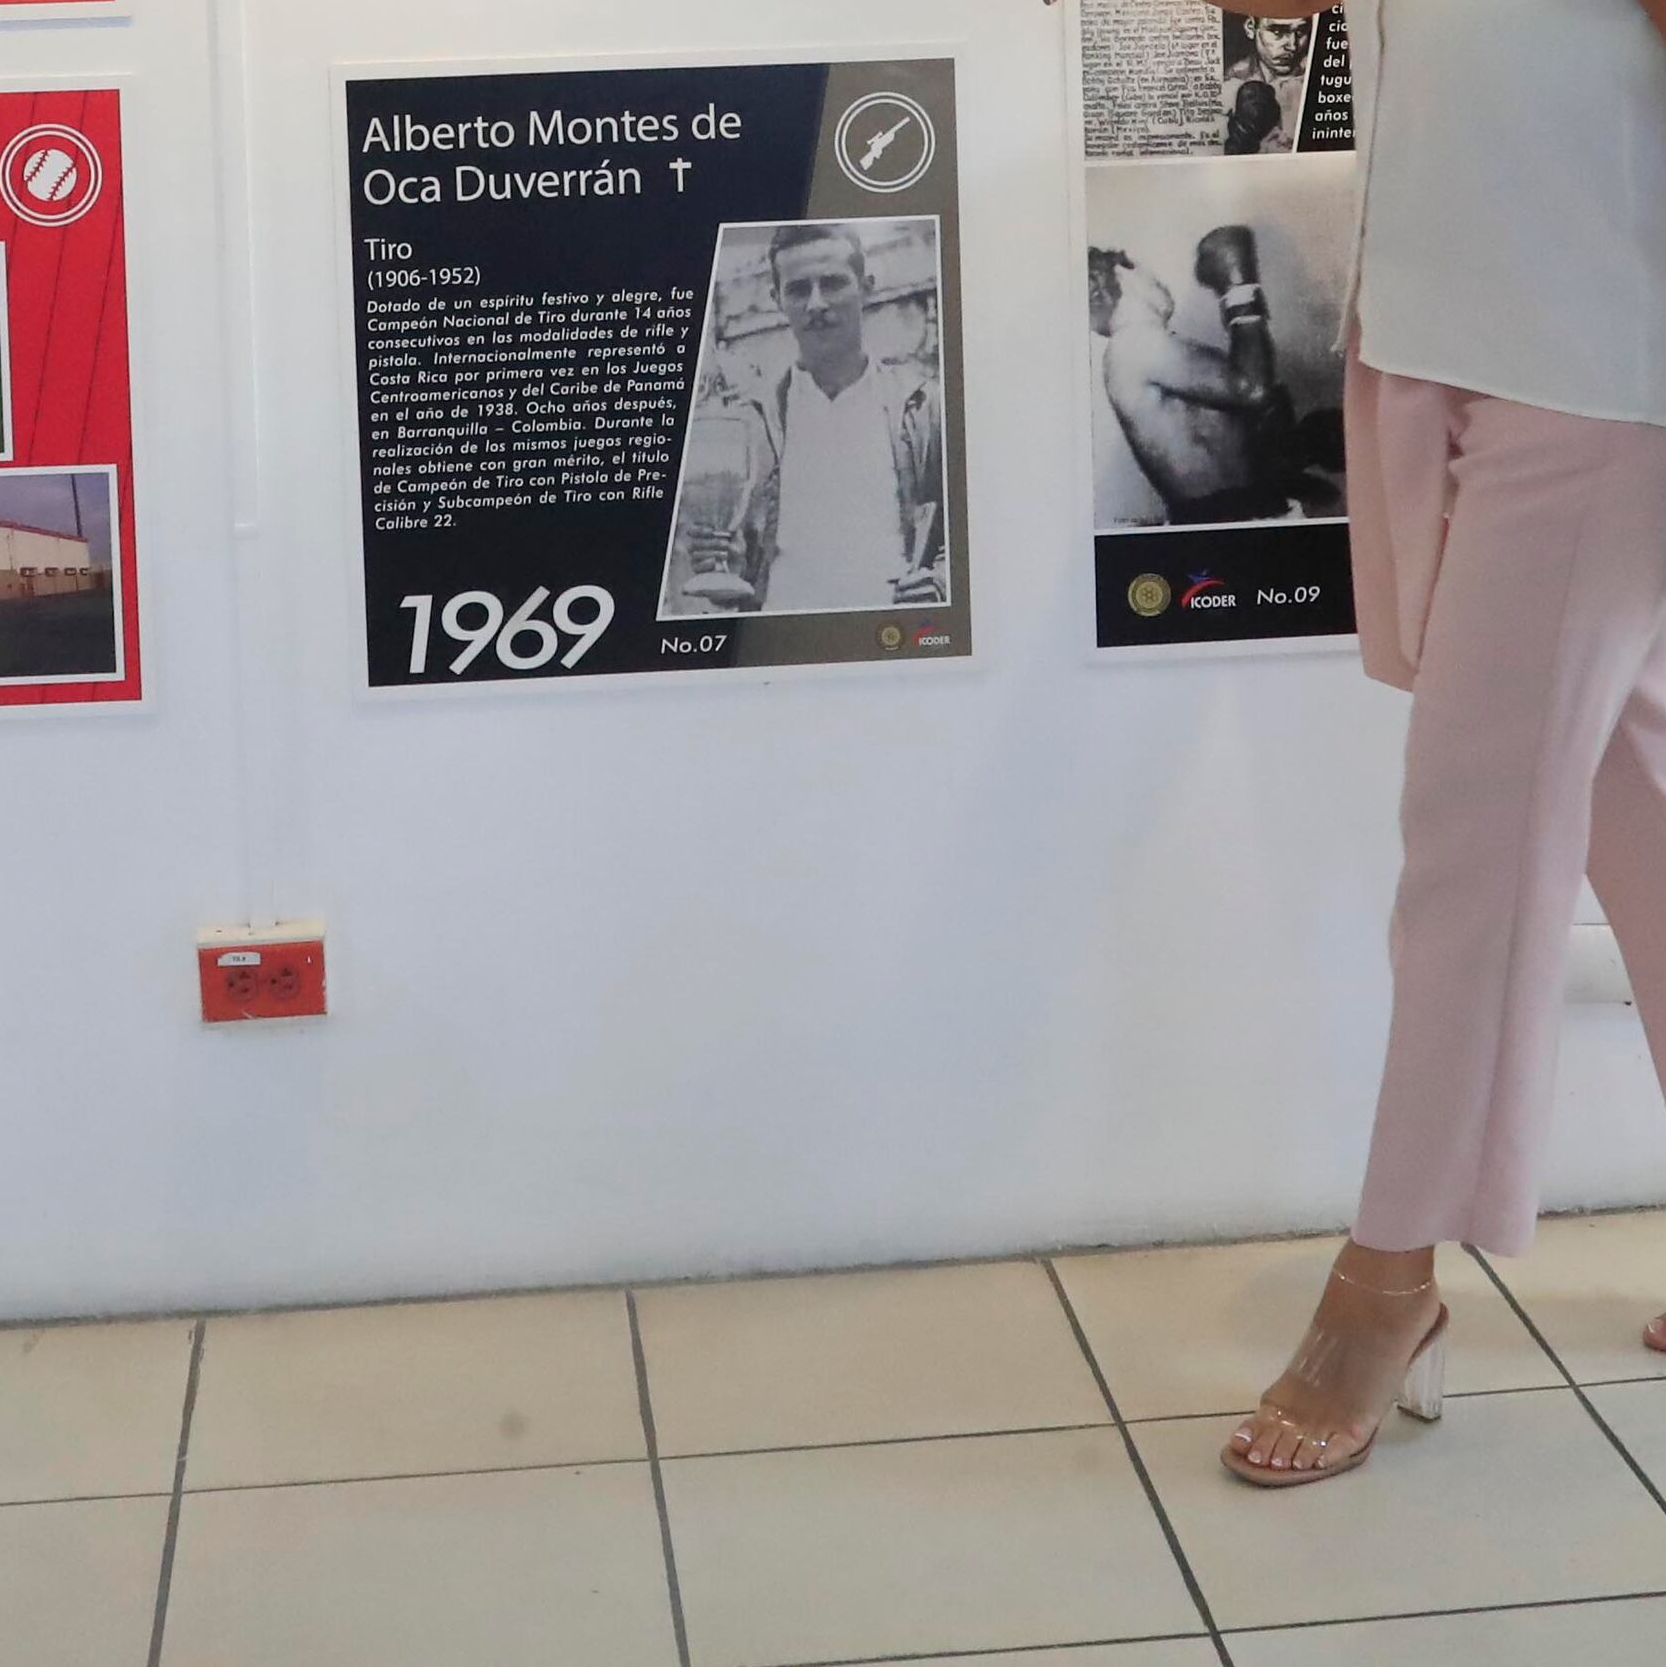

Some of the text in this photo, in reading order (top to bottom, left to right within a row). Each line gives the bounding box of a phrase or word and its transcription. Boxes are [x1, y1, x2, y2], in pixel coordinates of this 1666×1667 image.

[1323, 54, 1345, 68] del
[1314, 109, 1349, 122] años
[363, 103, 741, 153] Alberto Montes de
[364, 160, 641, 205] Oca Duverrán
[364, 238, 412, 260] Tiro
[368, 266, 480, 291] (1906-1952)
[376, 514, 456, 530] Calibre 22.
[1191, 595, 1236, 609] ICODER
[1257, 586, 1320, 604] No.09
[400, 585, 615, 675] 1969
[661, 636, 727, 654] No.07
